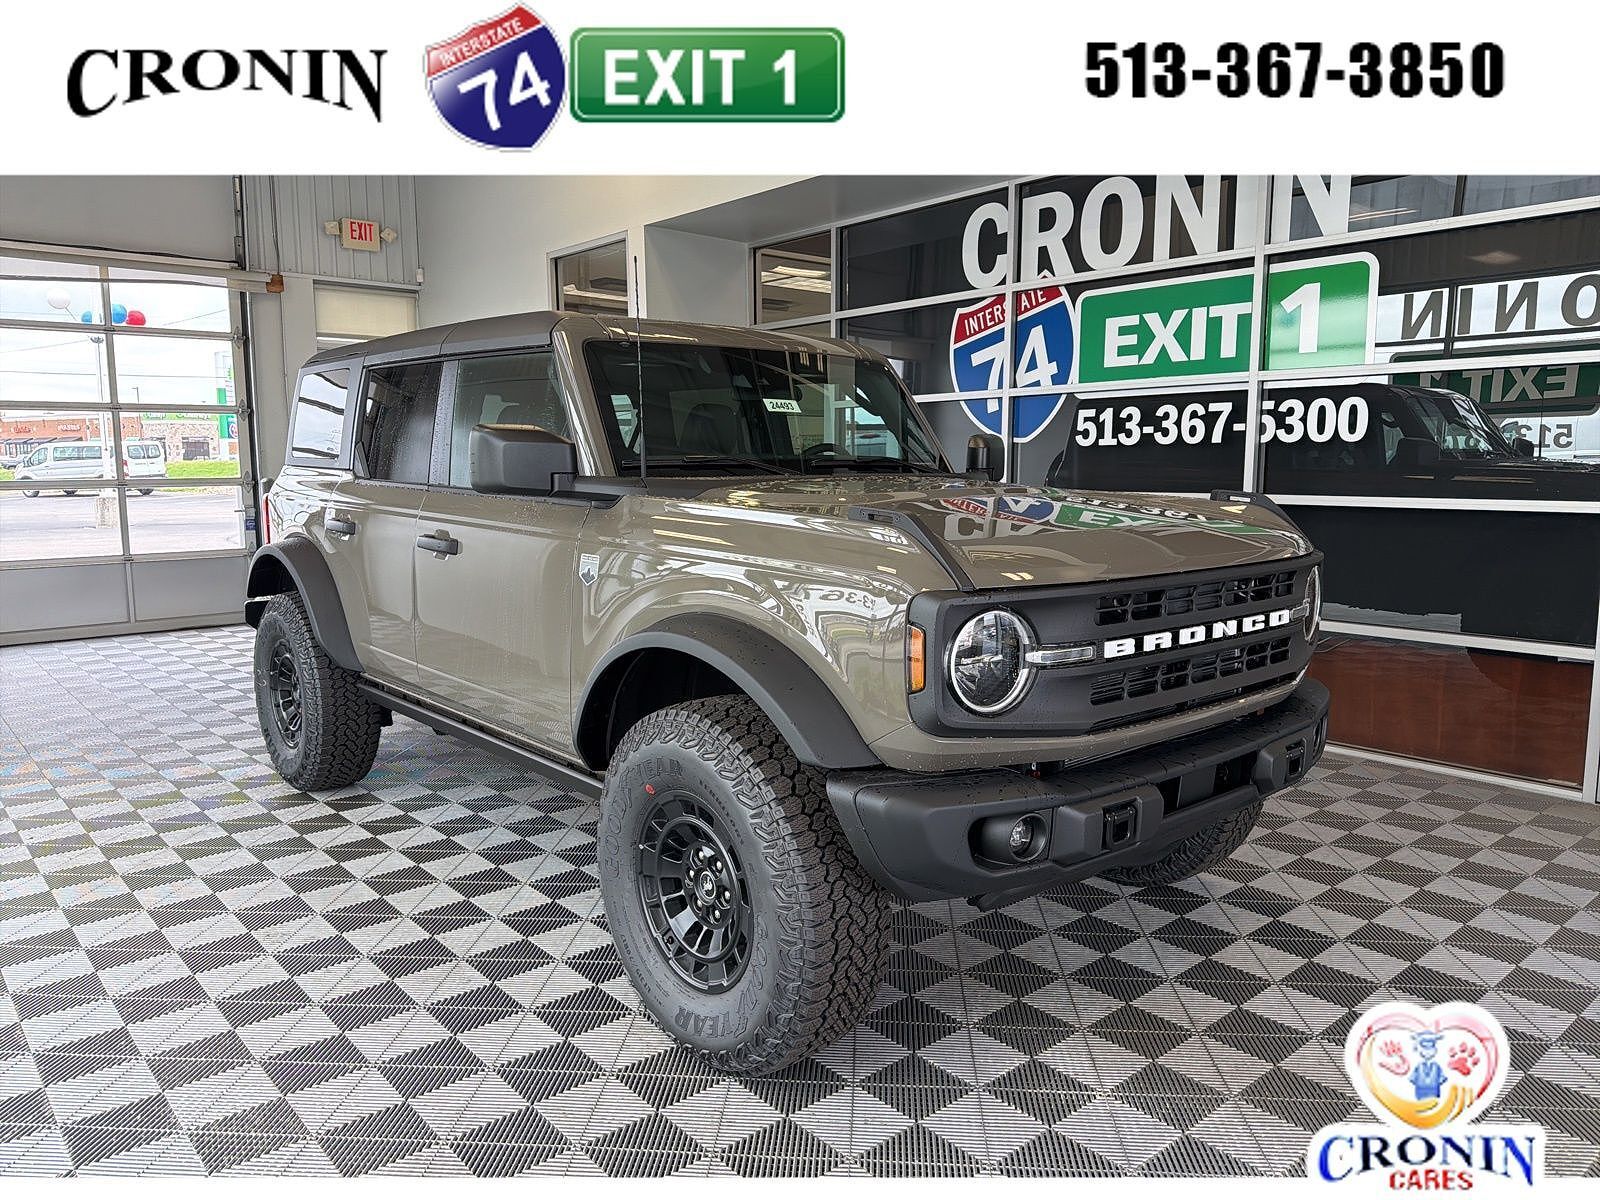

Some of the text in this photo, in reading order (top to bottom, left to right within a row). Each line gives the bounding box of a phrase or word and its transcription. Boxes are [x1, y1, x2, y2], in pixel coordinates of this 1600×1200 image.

[350, 220, 373, 241] EXIT
[1103, 283, 1321, 368] EXIT 1
[970, 325, 1059, 414] 74
[769, 401, 795, 411] 24493
[1075, 397, 1369, 446] 513-367-5300
[1103, 609, 1290, 659] BRONCO
